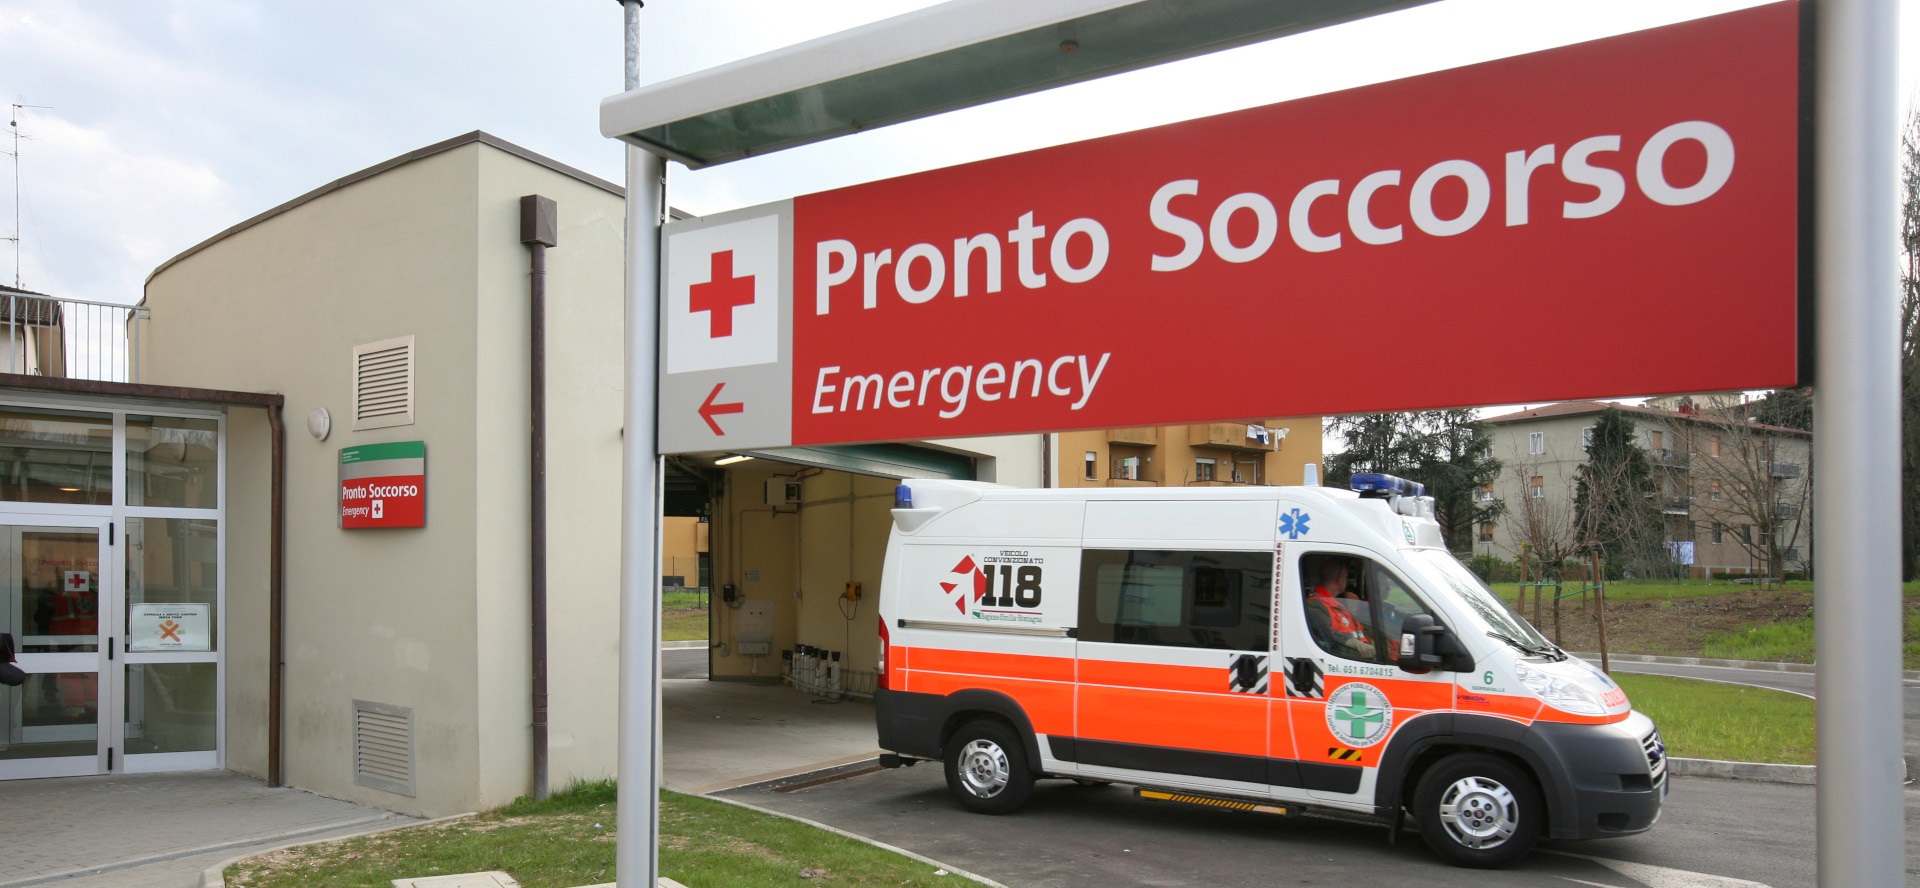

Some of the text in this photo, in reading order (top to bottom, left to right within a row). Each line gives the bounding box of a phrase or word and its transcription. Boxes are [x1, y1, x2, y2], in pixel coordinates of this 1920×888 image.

[816, 120, 1736, 316] Pronto Soccorso
[811, 352, 1111, 419] Emergency
[342, 483, 418, 500] Pronto Soccorso
[342, 506, 370, 518] Emergency
[75, 559, 99, 567] Socco
[983, 556, 1044, 564] CONVENZIONATO
[981, 564, 1042, 608] 118
[1327, 664, 1394, 677] Tel. 051 6704815
[1483, 670, 1494, 685] 6
[1471, 685, 1505, 693] SERRAVALLE
[1456, 694, 1486, 702] VISION
